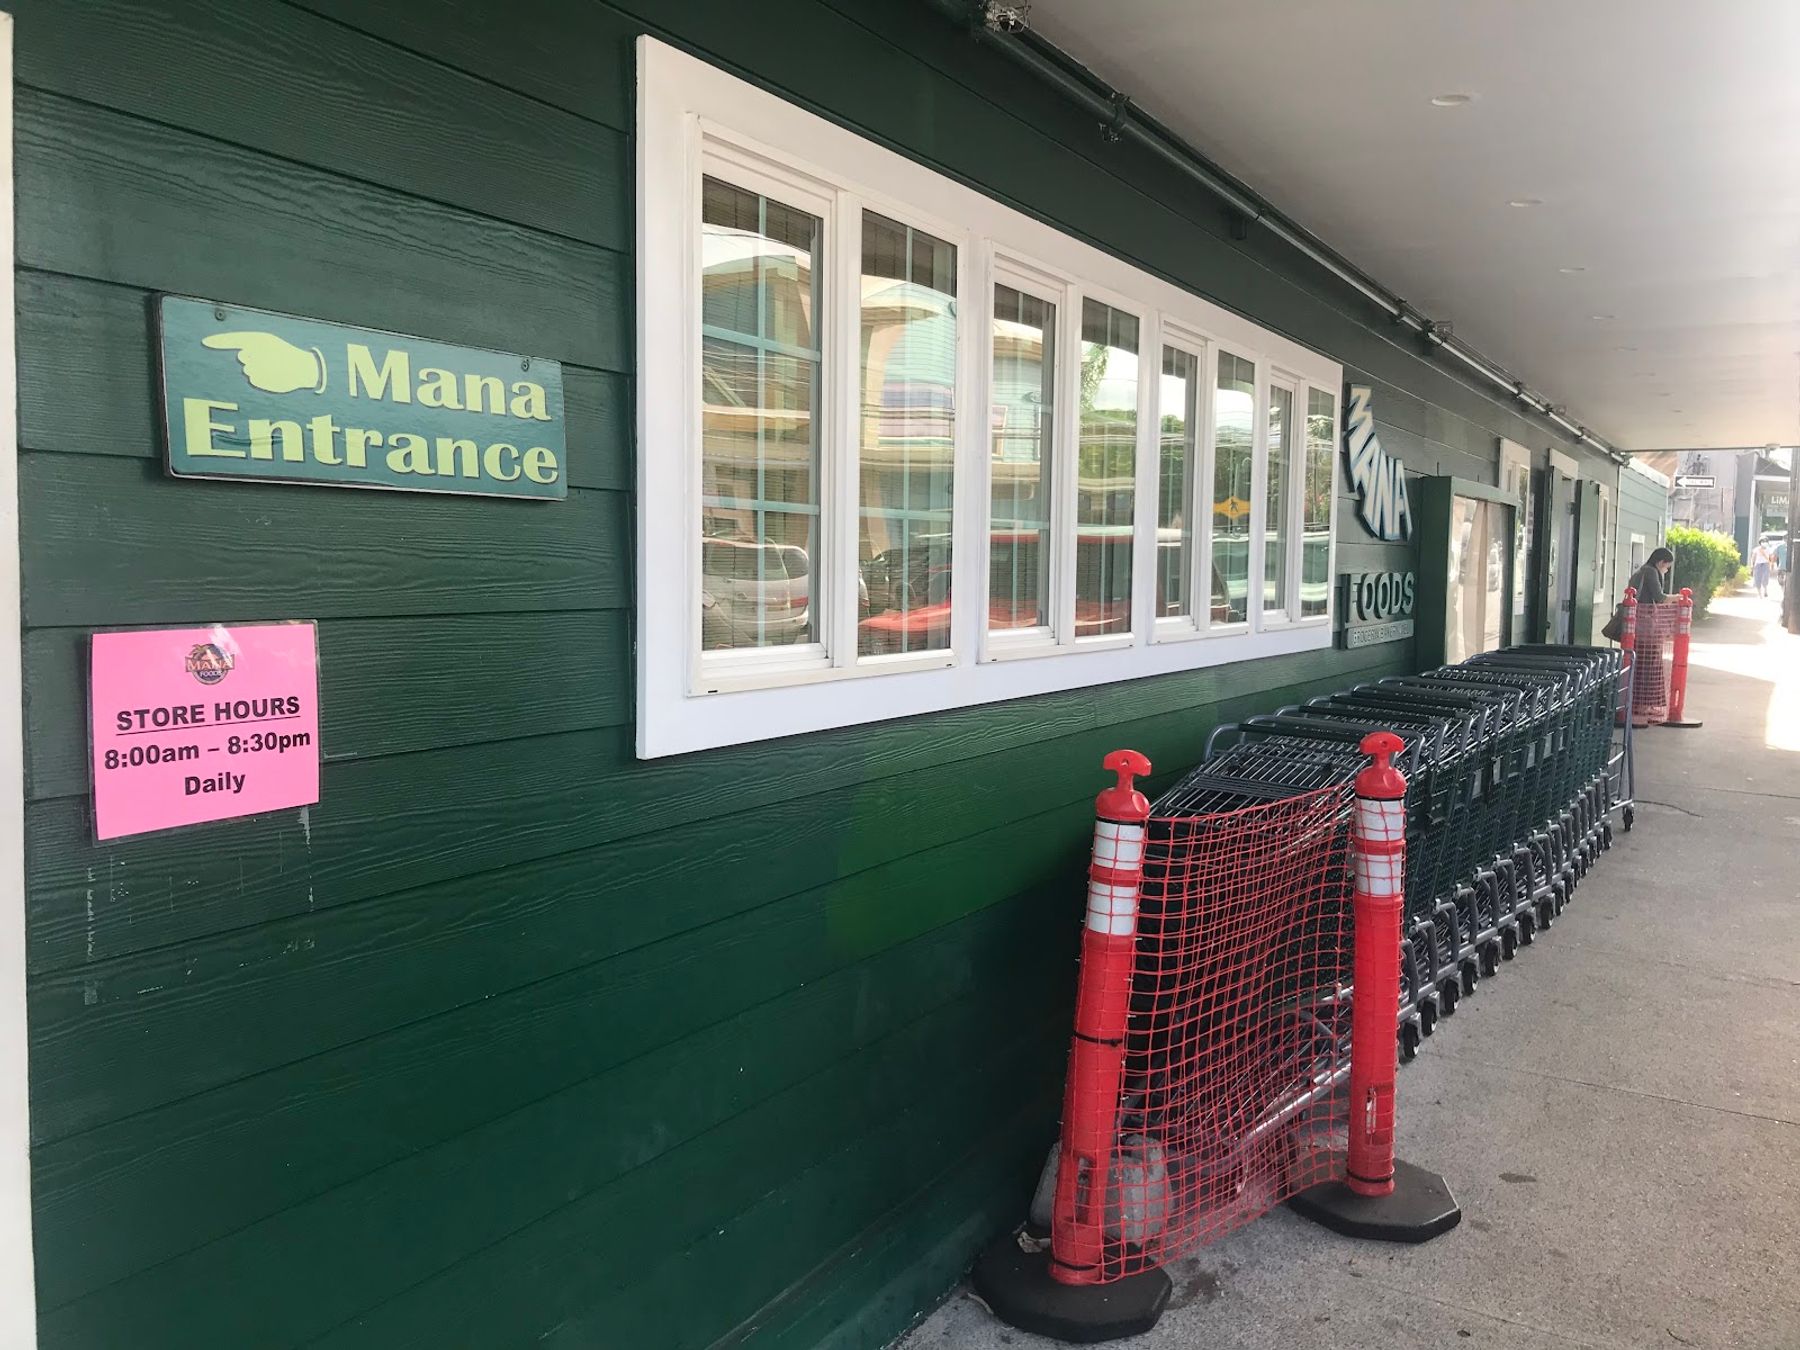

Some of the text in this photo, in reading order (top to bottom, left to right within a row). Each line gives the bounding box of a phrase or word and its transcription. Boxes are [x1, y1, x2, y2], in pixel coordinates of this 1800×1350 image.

[347, 343, 552, 421] Mana
[183, 397, 559, 484] Entrance
[1348, 383, 1413, 541] MANA
[1349, 572, 1415, 621] FOODS
[116, 696, 300, 730] STORE HOURS
[104, 744, 199, 769] 8:00am
[227, 732, 310, 755] 8:30pm
[185, 772, 246, 795] Daily
